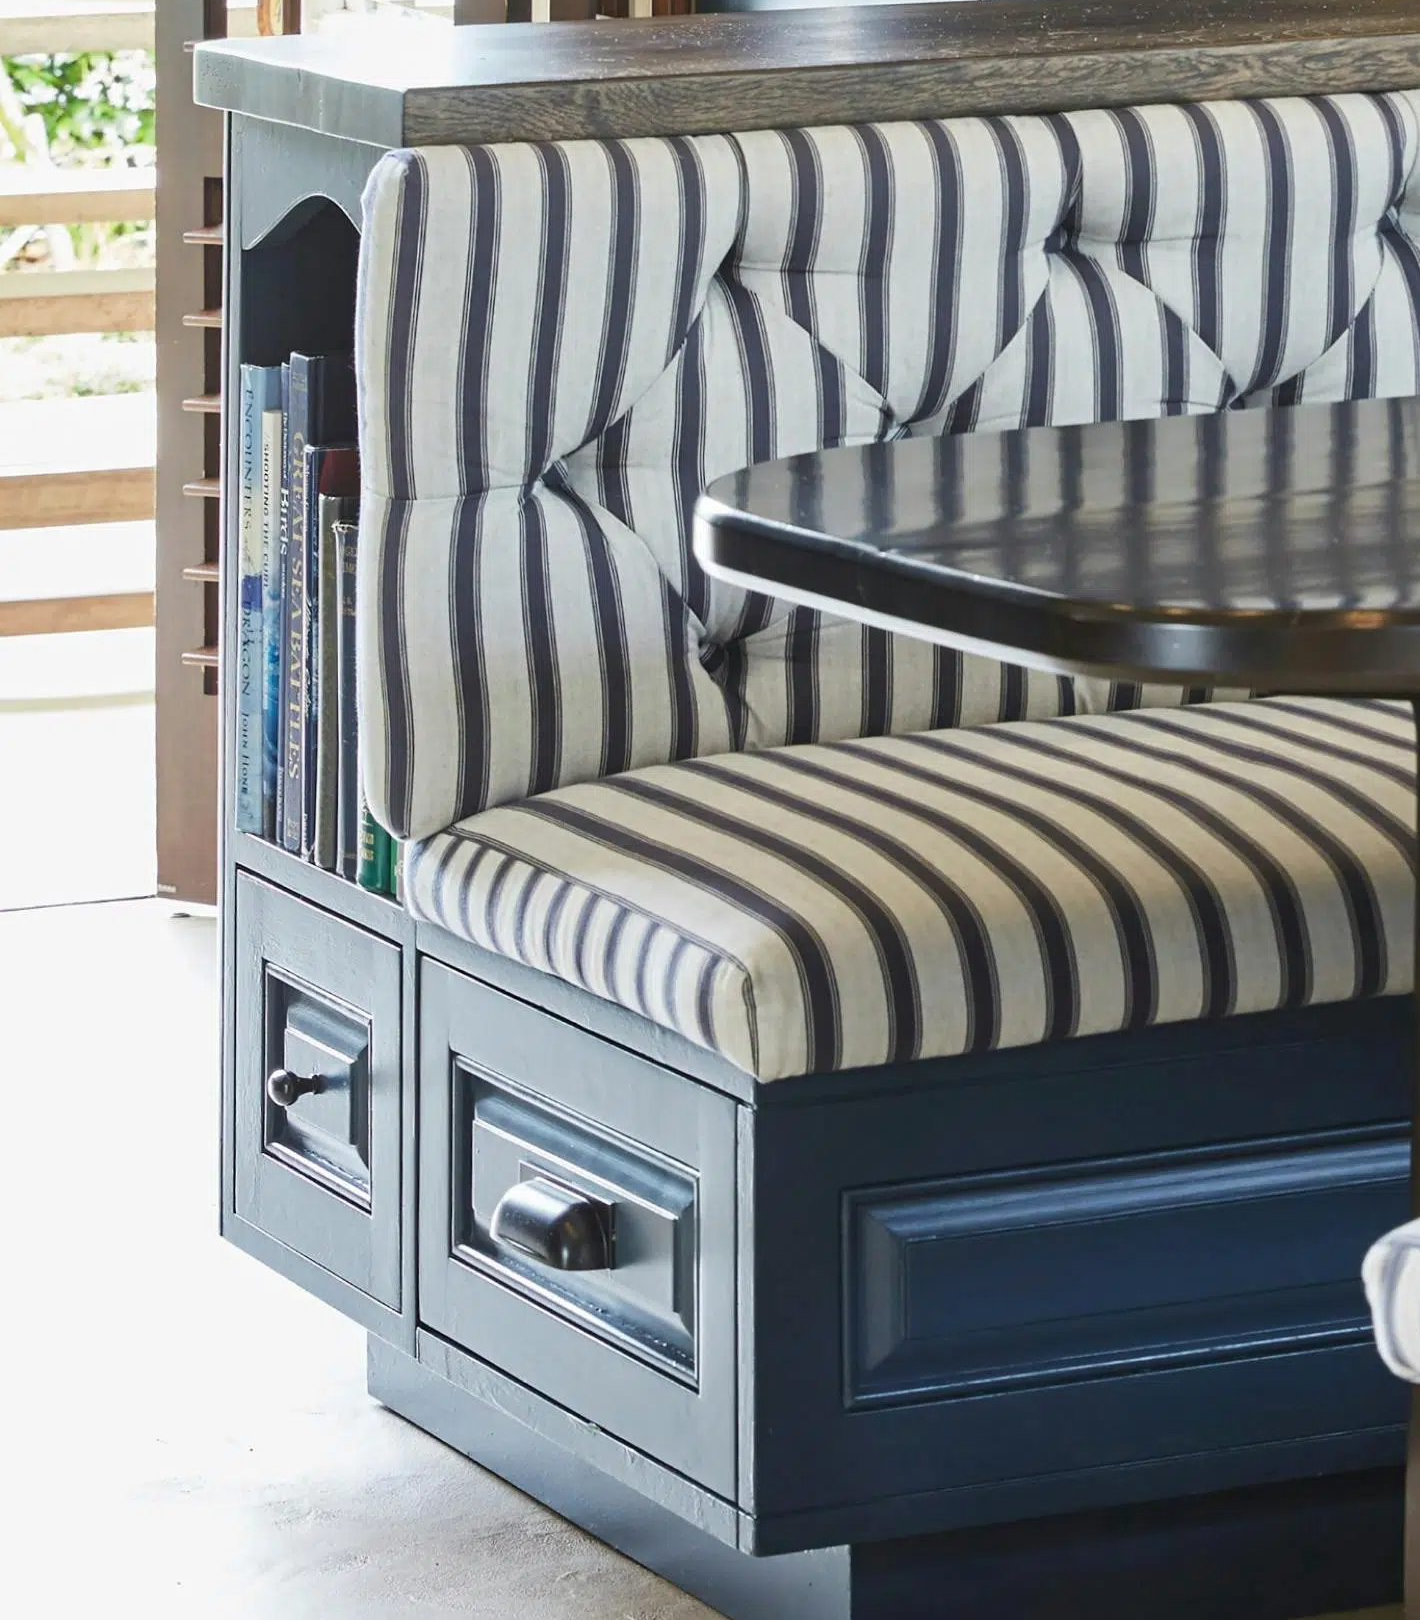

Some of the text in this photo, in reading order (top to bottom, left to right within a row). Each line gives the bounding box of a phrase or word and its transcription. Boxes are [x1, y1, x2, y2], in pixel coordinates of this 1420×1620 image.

[243, 389, 254, 529] ENCOUNTERS
[280, 488, 289, 555] Birds
[242, 600, 253, 696] DRAGON
[288, 432, 304, 780] GREAT SEA BATTLES
[241, 713, 250, 748] JOHN
